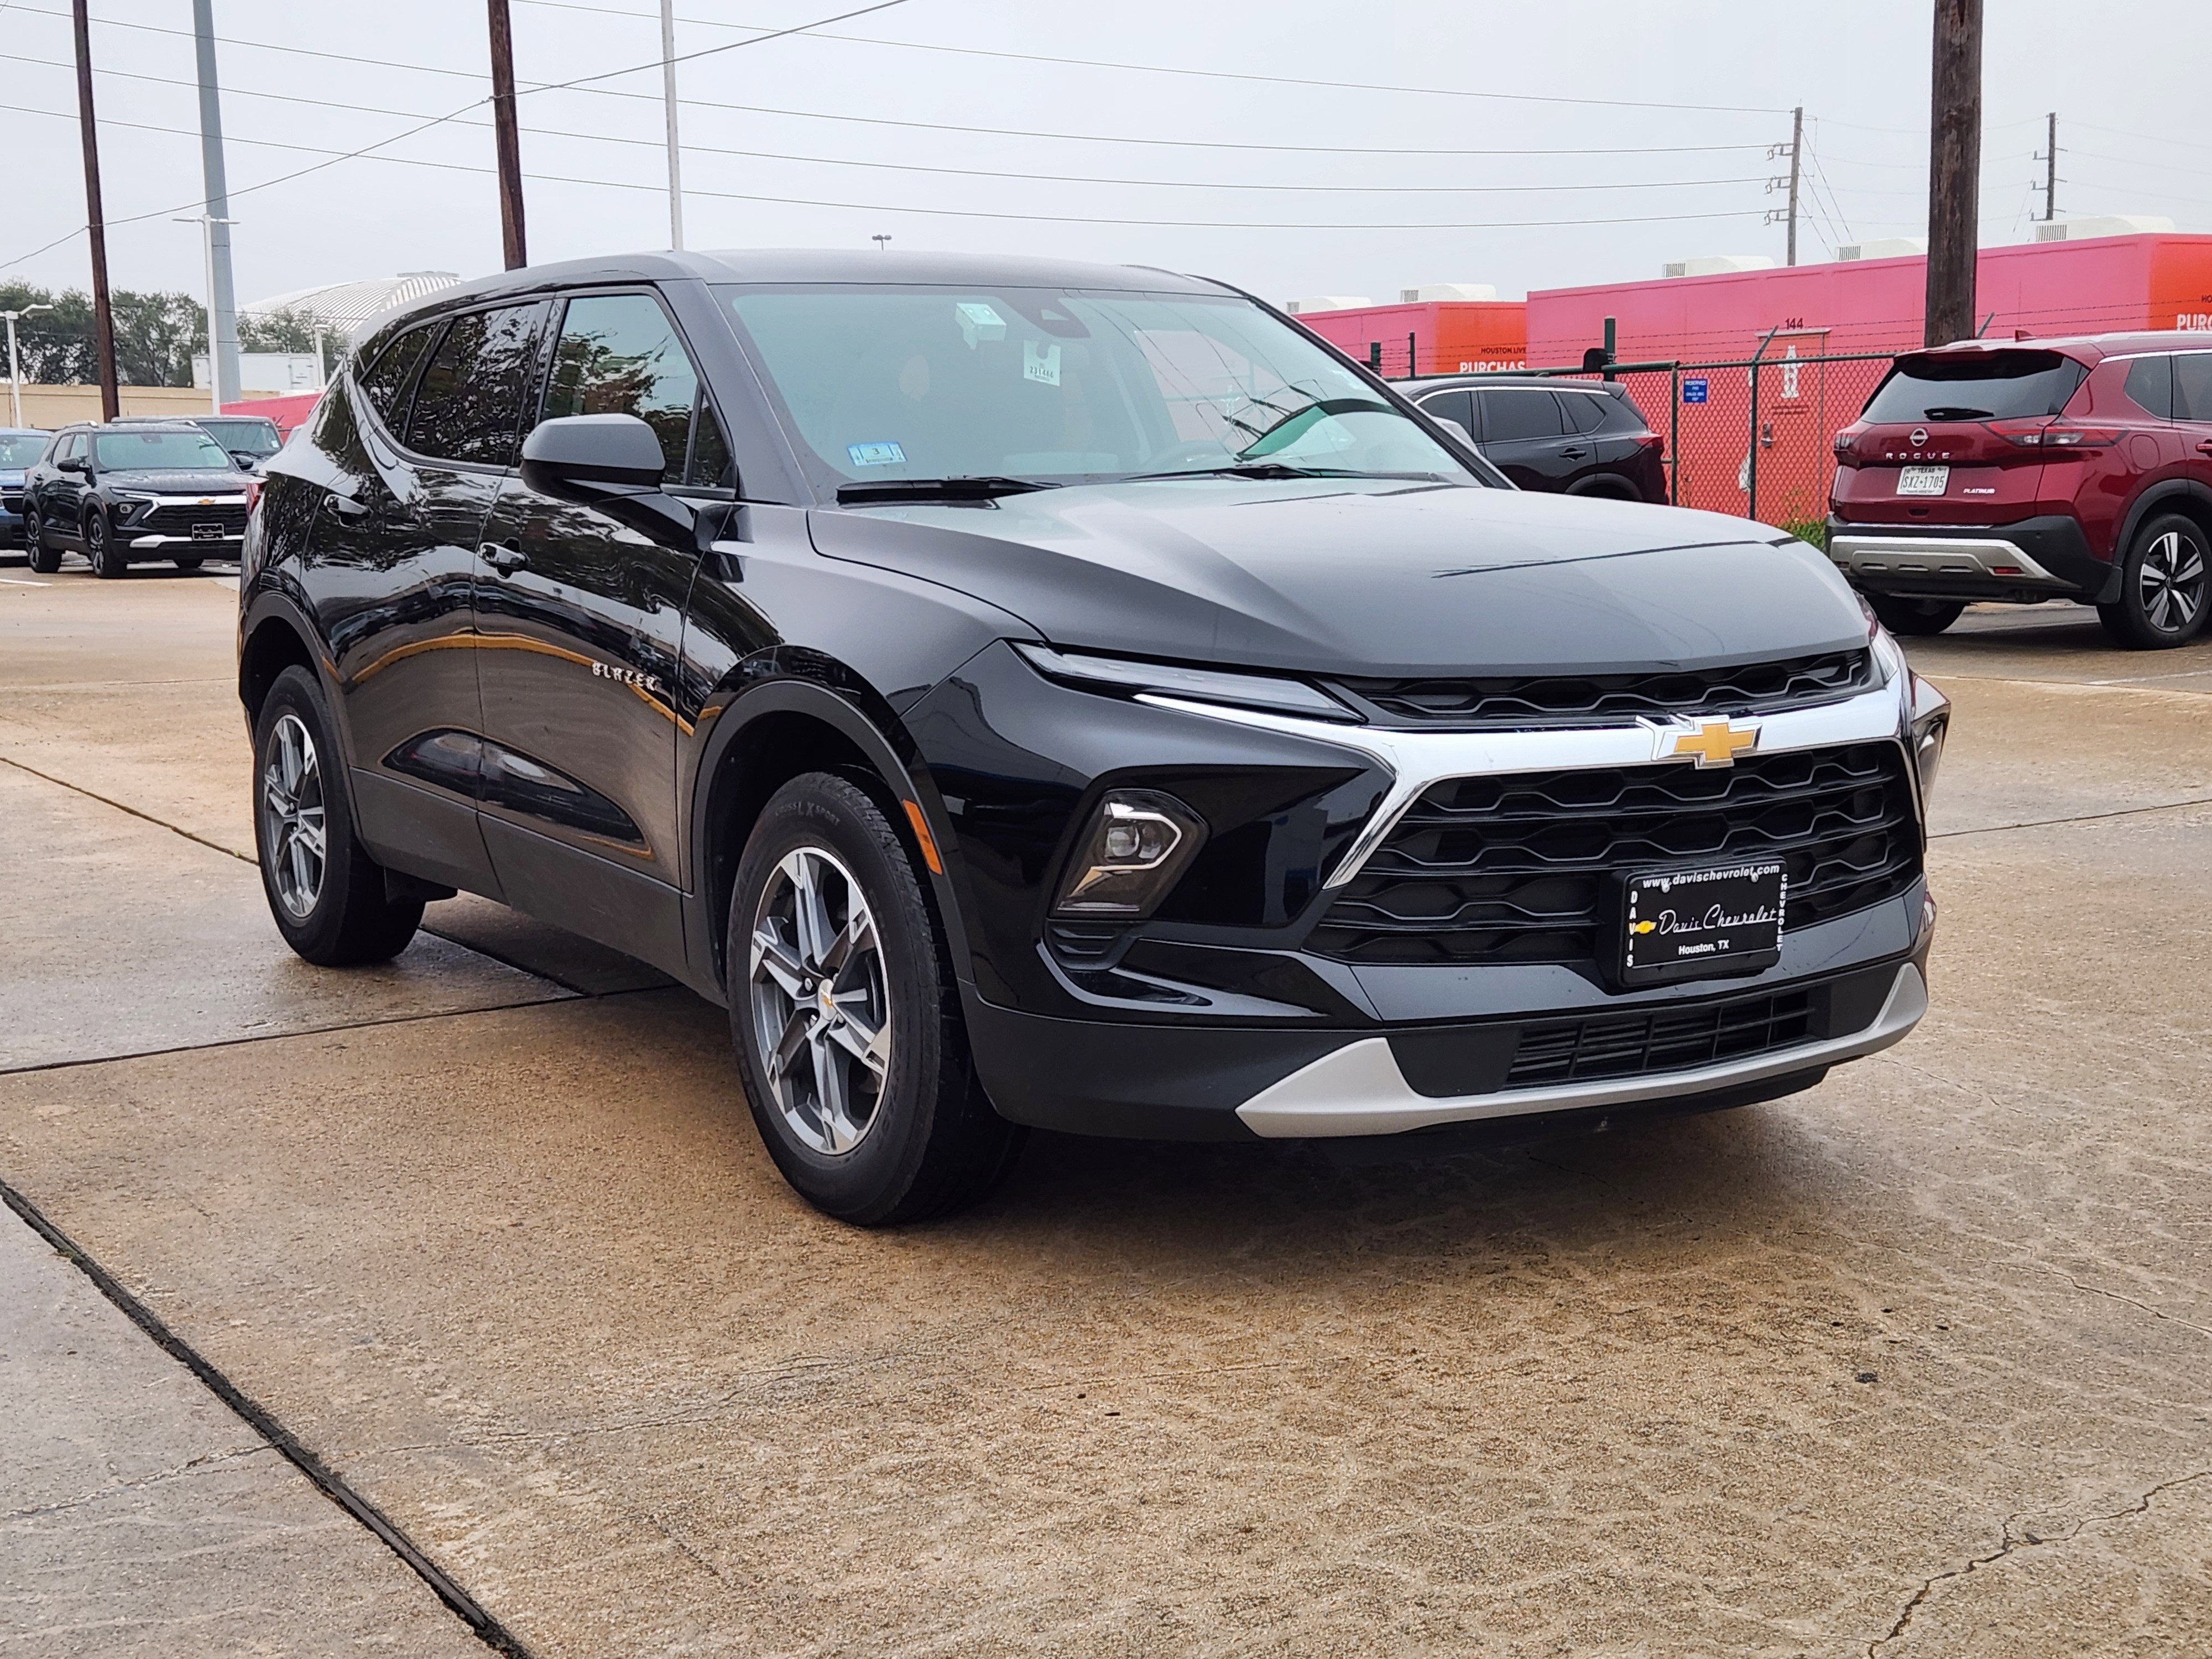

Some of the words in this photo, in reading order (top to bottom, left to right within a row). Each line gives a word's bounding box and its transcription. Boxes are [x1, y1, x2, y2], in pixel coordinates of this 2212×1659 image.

[1785, 317, 1803, 330] 144
[592, 661, 656, 691] BLAZER
[1643, 864, 1780, 888] www.davischevrolet.com
[1658, 909, 1703, 935] Davis
[1703, 904, 1777, 930] Chevrolet
[1776, 874, 1788, 952] CHEVROLET
[1626, 890, 1639, 967] DAVIS
[1678, 942, 1716, 956] Houston,
[1717, 940, 1730, 950] TX
